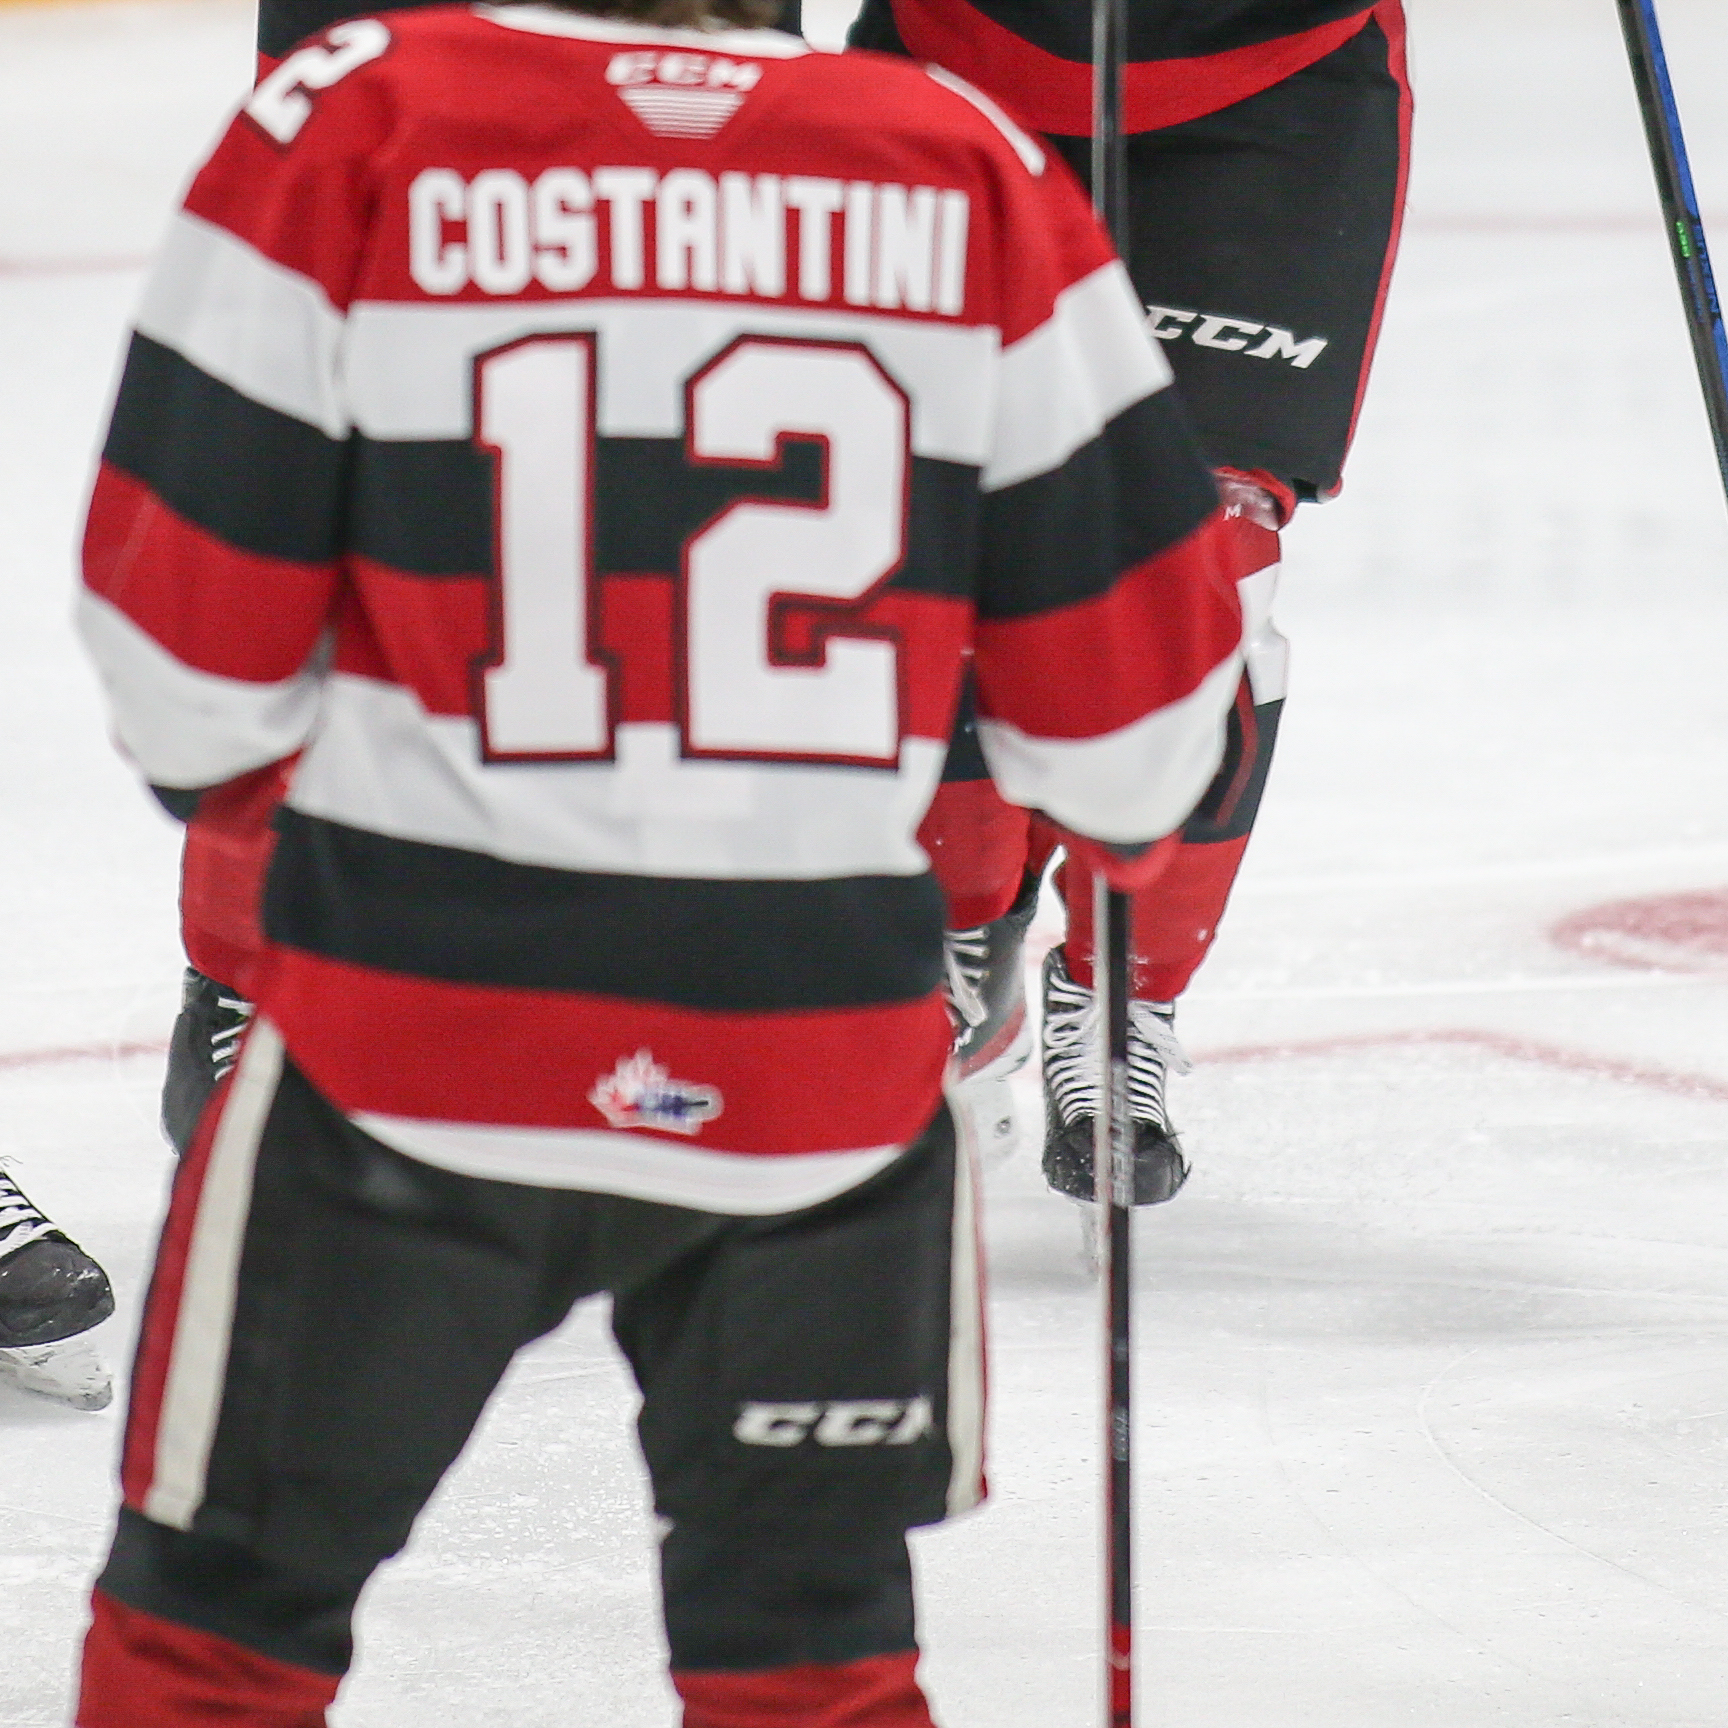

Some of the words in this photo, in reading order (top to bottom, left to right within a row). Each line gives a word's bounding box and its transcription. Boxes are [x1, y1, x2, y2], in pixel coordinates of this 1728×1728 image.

[604, 50, 766, 93] CCM
[408, 164, 971, 318] COSTANTINI
[1144, 305, 1329, 369] CCM
[469, 331, 912, 769] 12
